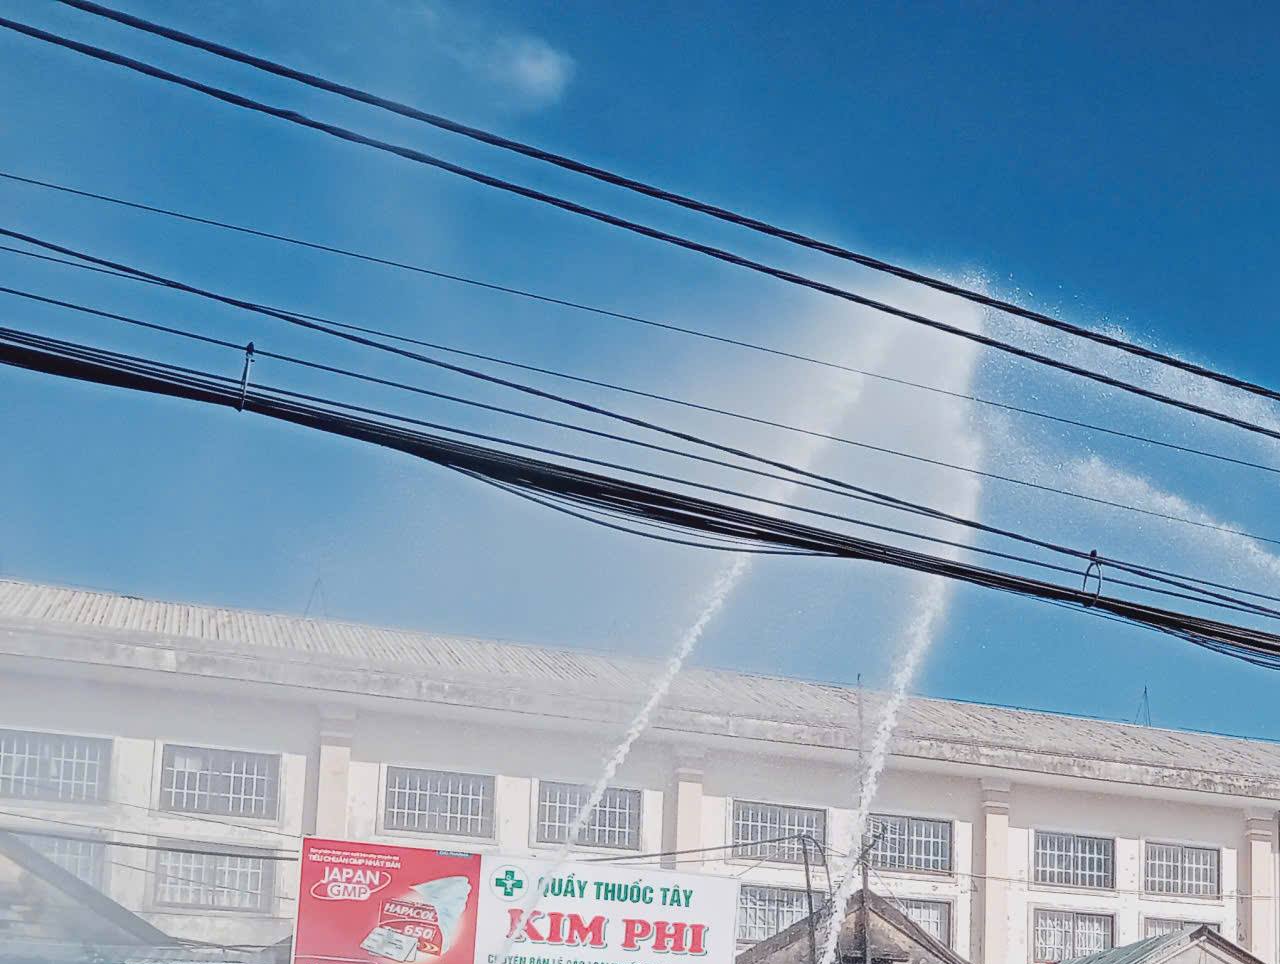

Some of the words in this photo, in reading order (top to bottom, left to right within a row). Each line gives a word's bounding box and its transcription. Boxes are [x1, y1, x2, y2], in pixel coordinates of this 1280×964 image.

[321, 867, 380, 885] JAPAN
[330, 884, 368, 898] GMP
[594, 879, 654, 904] THUỐC
[660, 884, 693, 908] TÂY
[384, 903, 435, 920] HAPACOL
[404, 925, 433, 939] 650
[506, 908, 608, 948] KIM
[621, 917, 708, 955] PHI
